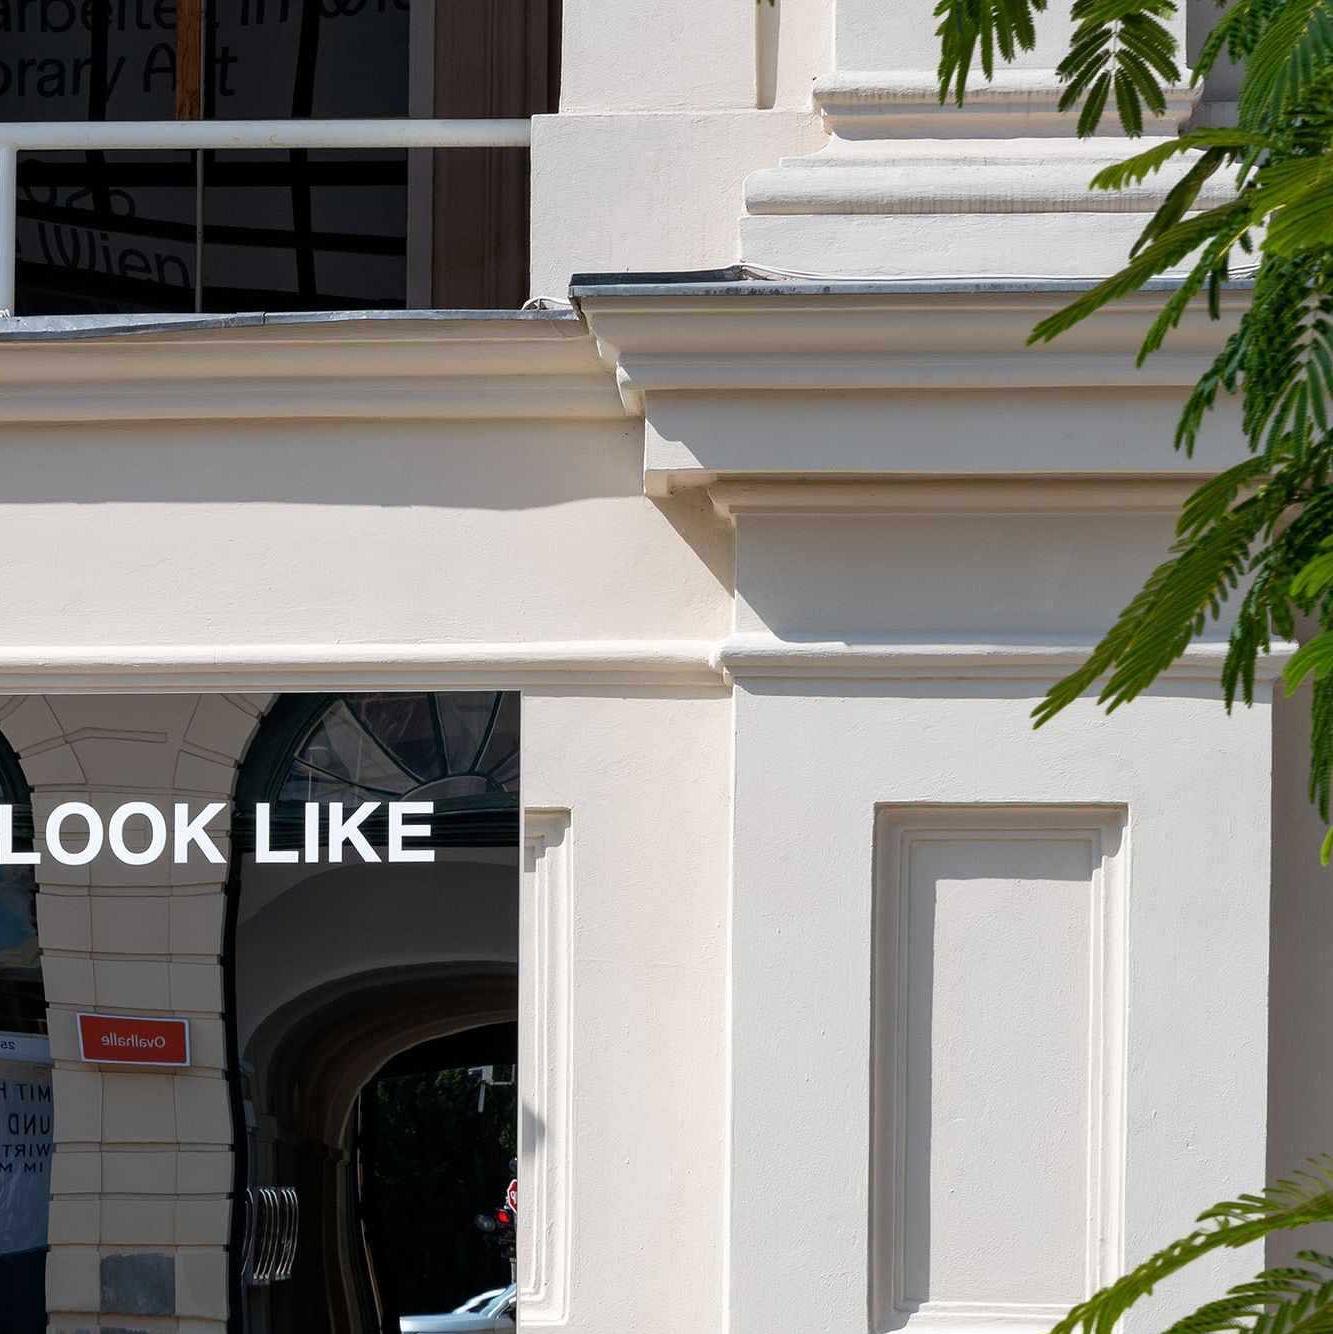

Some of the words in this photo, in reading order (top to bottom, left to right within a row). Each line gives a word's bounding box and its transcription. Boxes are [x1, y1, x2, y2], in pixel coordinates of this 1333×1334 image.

[143, 41, 238, 98] At
[0, 802, 226, 864] LOOK
[256, 802, 434, 862] LIKE
